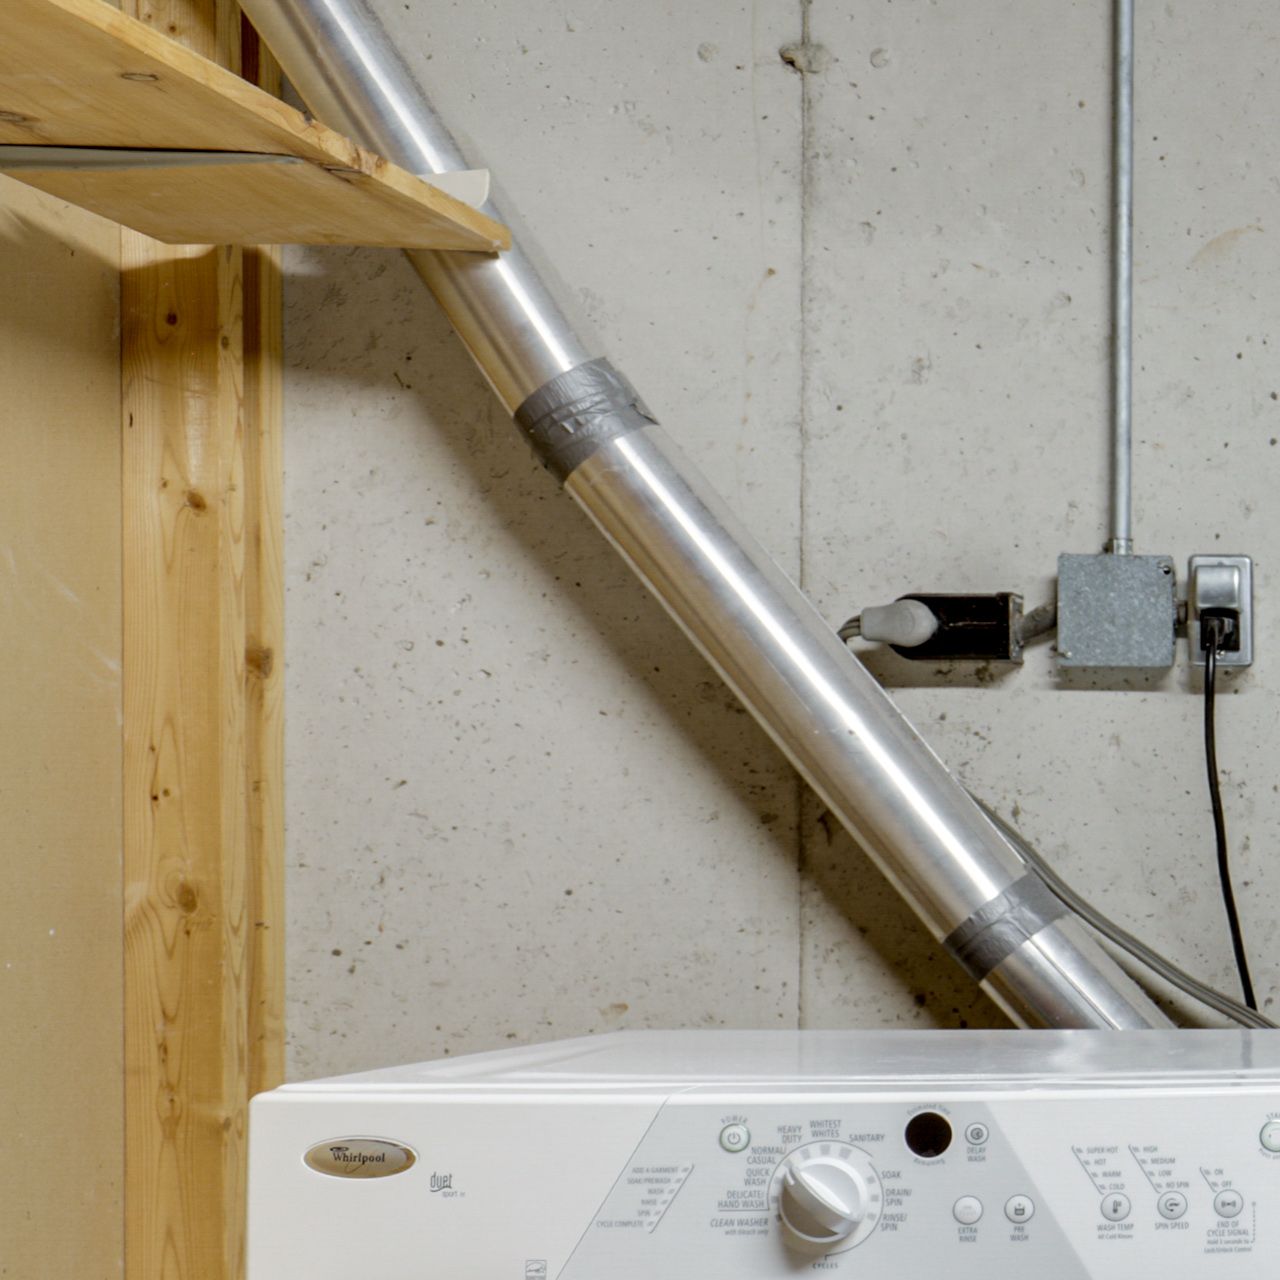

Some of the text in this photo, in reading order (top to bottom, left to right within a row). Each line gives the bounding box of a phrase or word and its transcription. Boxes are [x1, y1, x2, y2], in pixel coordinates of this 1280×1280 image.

[720, 1115, 748, 1124] POWER
[809, 1119, 841, 1128] WHITEST
[777, 1125, 803, 1134] HEAVY
[811, 1129, 840, 1138] WHITES
[781, 1135, 803, 1144] DUTY
[849, 1133, 885, 1142] SANITARY
[966, 1146, 986, 1154] DELAY
[1086, 1146, 1105, 1154] SUPER
[332, 1152, 386, 1165] Whirlpool
[746, 1156, 777, 1165] CASUAL
[967, 1154, 986, 1162] WASH
[745, 1168, 770, 1177] QUICK
[881, 1170, 902, 1179] SOAK
[429, 1171, 453, 1190] duet
[743, 1178, 767, 1186] WASH
[717, 1199, 765, 1208] HAND WASH
[886, 1198, 903, 1207] SPIN
[710, 1218, 769, 1228] CLEAN WASHER
[880, 1222, 898, 1232] SPIN
[1096, 1223, 1116, 1231] WASH
[1154, 1222, 1190, 1230] SPIN SPEED
[1216, 1220, 1230, 1228] END
[957, 1227, 978, 1235] EXTRA
[1206, 1229, 1226, 1237] CYCLE
[1010, 1234, 1029, 1242] WASH
[812, 1261, 839, 1269] CYCLES
